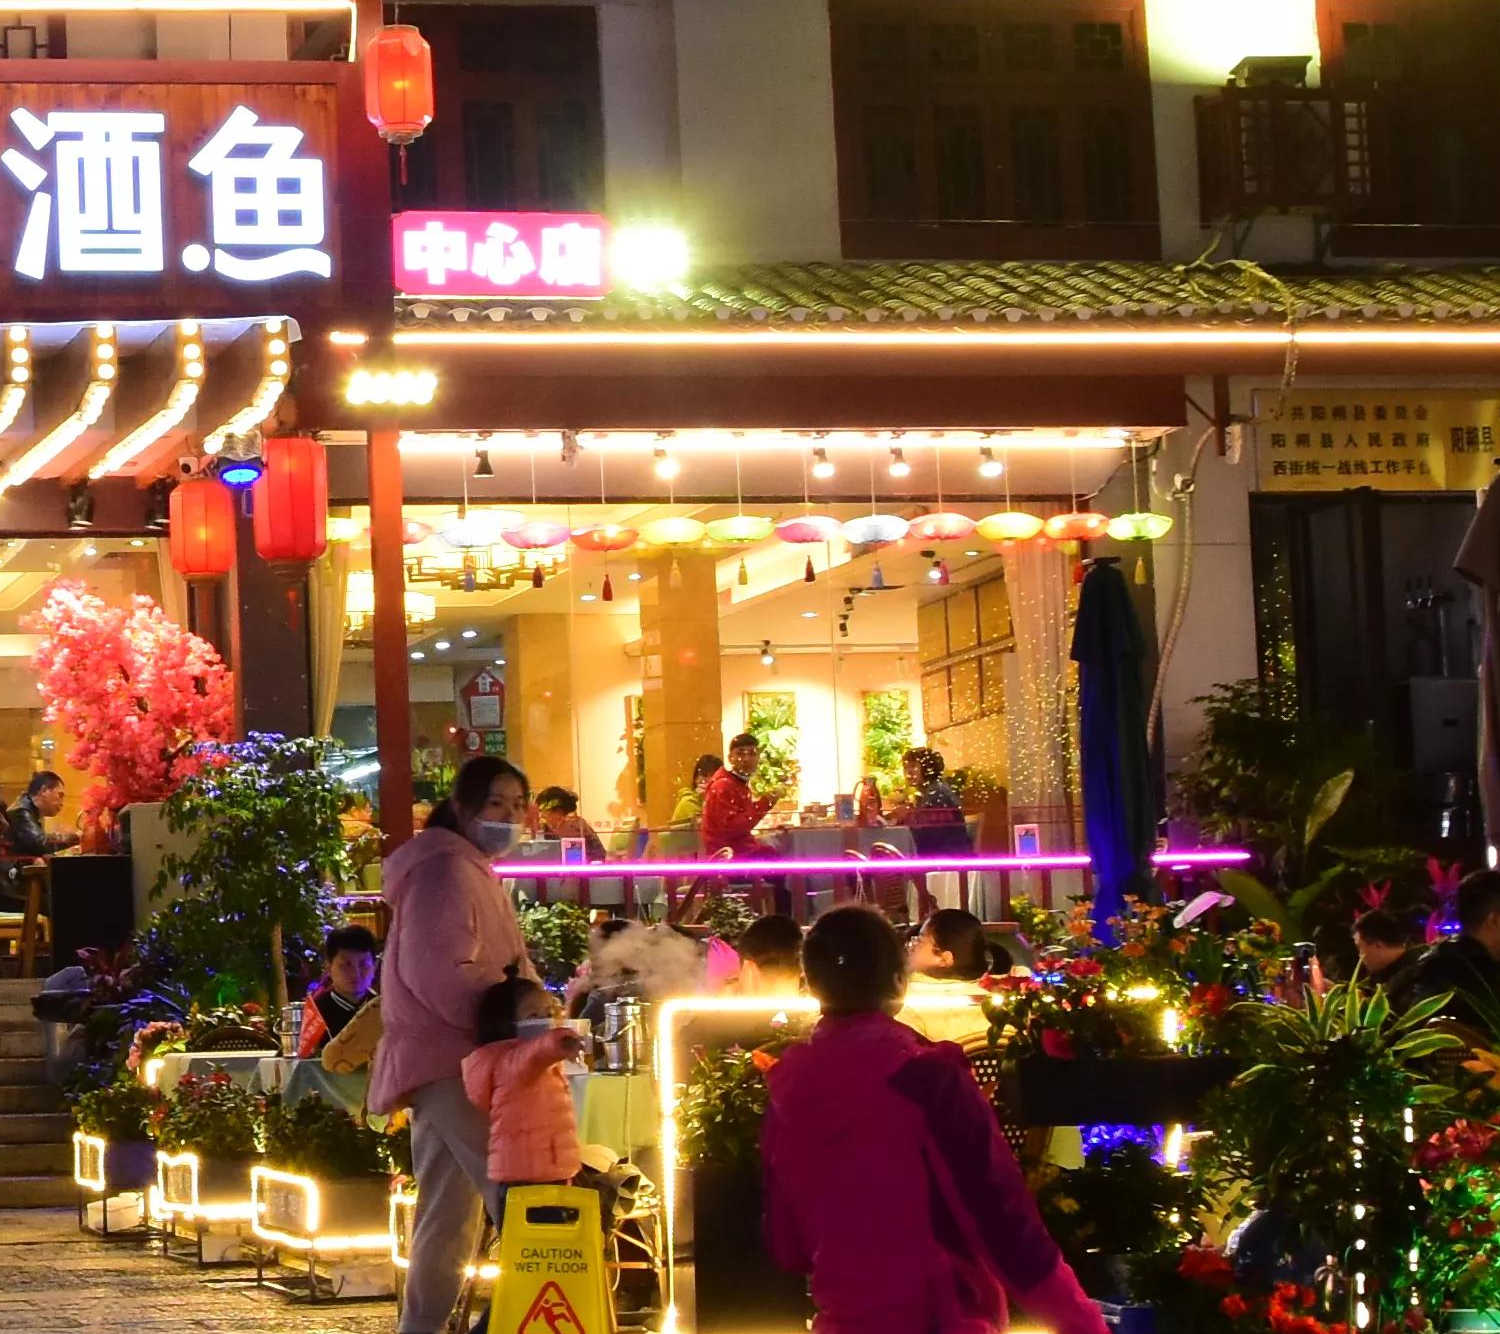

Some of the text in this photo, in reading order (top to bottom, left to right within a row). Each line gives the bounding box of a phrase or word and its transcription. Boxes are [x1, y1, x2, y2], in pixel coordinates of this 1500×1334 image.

[403, 221, 602, 286] 中心店
[1271, 433, 1431, 448] 阳朔县人民政府
[1273, 460, 1431, 475] 西街统一战线工作平台
[520, 1248, 583, 1260] CAUTION
[514, 1262, 588, 1273] WET FLOOR
